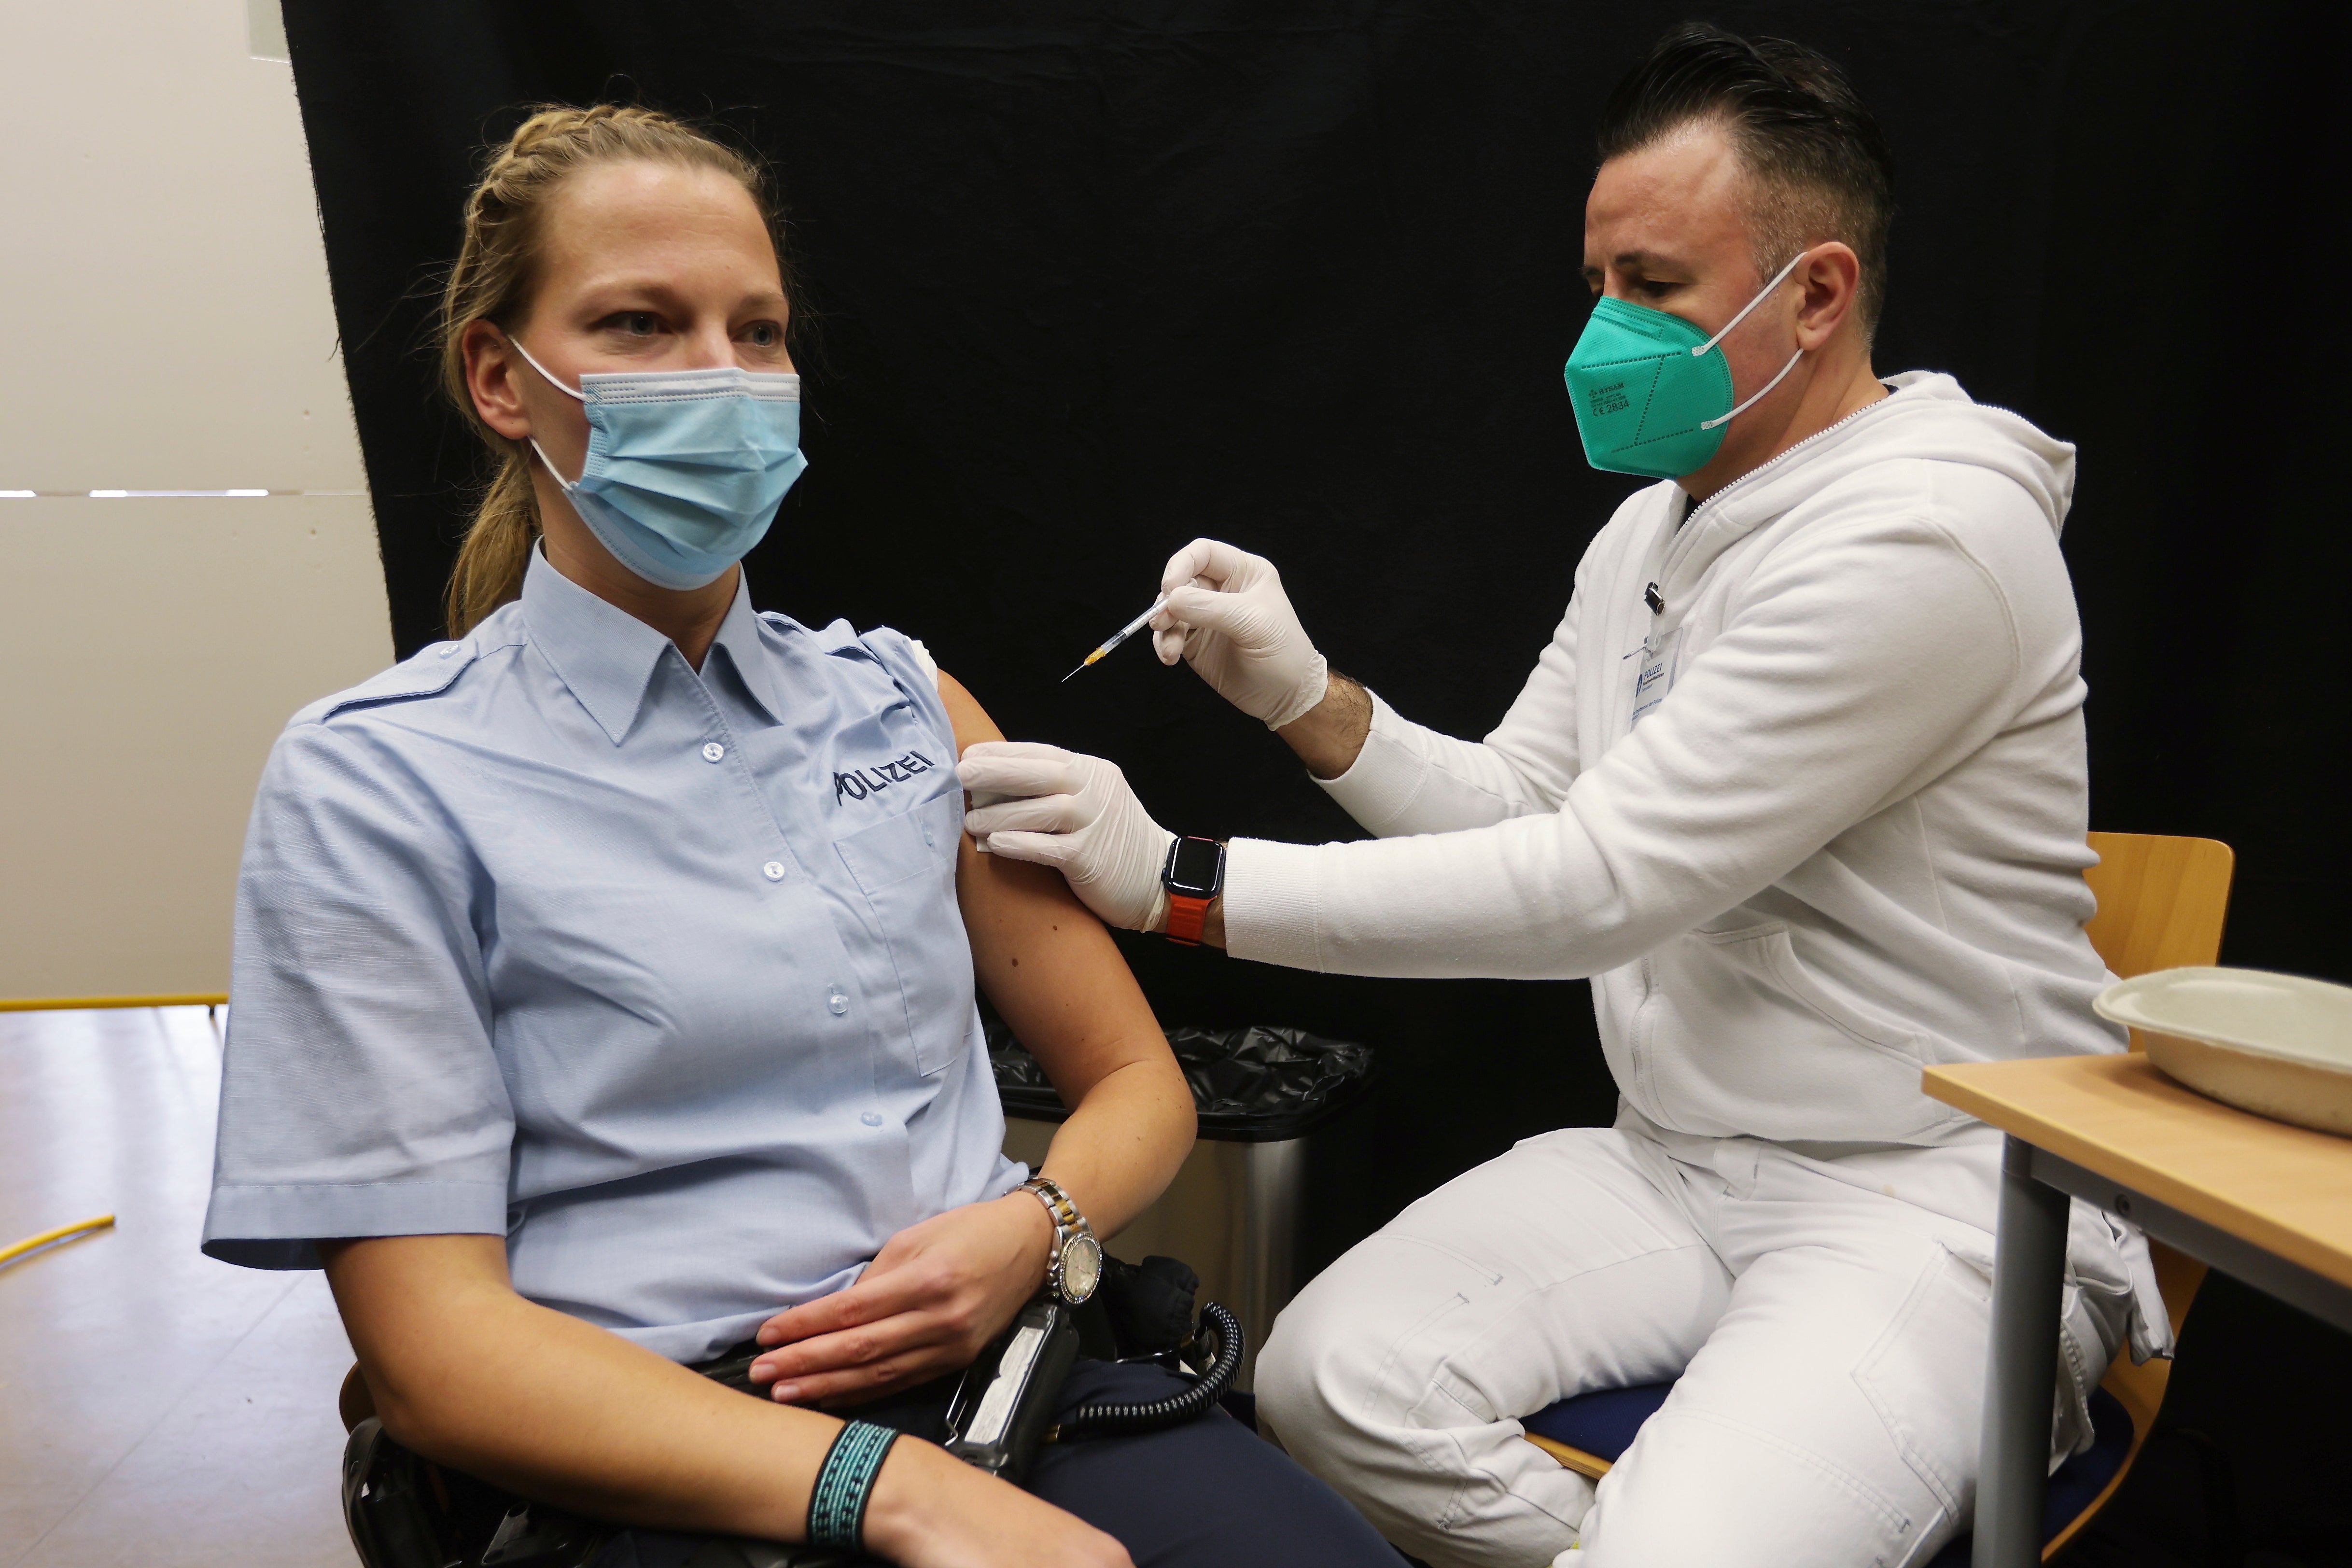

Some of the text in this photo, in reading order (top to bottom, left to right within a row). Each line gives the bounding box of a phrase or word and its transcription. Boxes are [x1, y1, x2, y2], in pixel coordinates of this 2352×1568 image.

[1606, 400, 1629, 413] 2834
[1644, 662, 1662, 680] POLIZEI
[833, 750, 935, 806] POLIZEI
